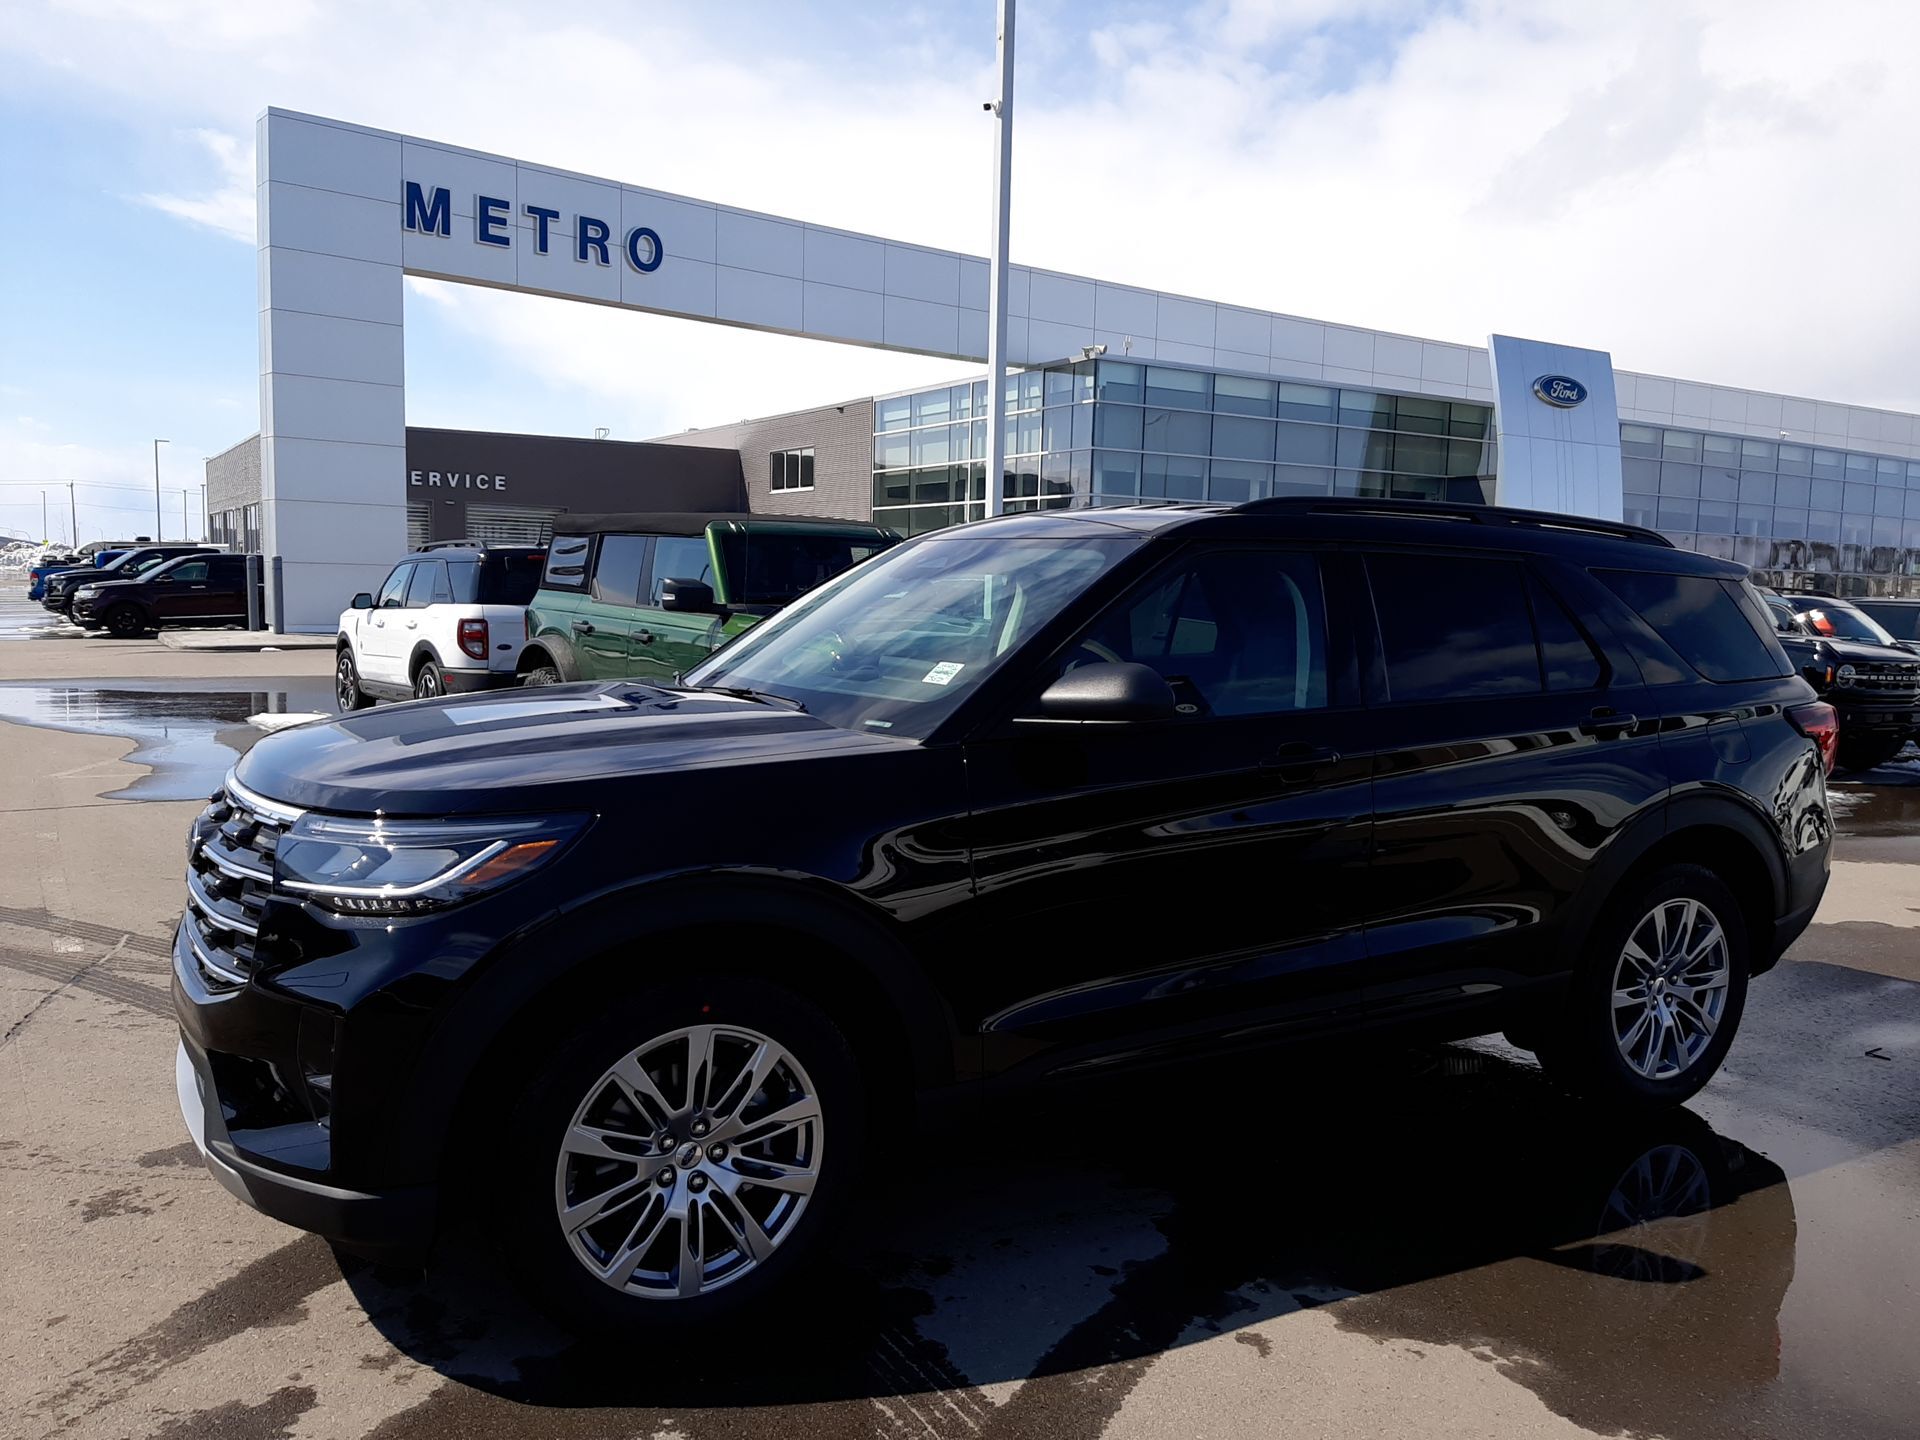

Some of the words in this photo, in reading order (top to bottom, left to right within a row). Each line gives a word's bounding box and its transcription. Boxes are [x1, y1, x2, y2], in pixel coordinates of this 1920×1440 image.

[403, 181, 664, 274] METRO
[1550, 380, 1578, 400] Ford
[410, 470, 506, 490] ERVICE
